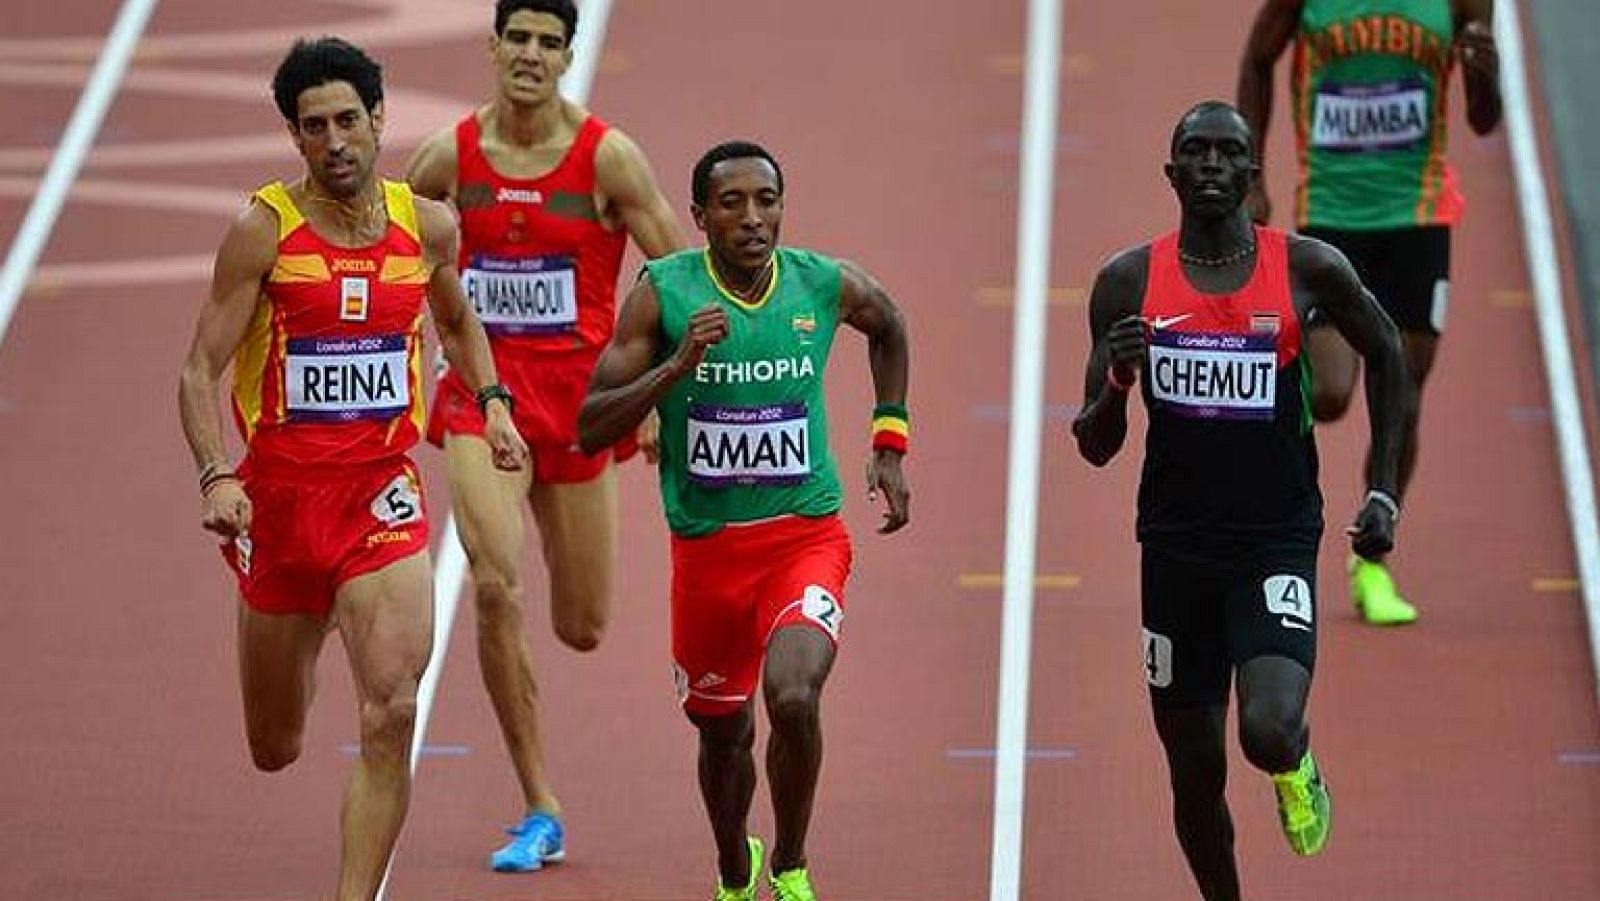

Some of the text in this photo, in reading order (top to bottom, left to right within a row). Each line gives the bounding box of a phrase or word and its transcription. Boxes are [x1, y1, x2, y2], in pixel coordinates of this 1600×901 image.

[1320, 101, 1423, 136] MUMBA
[467, 277, 566, 316] EL MANAOUI
[315, 338, 383, 353] London 2012
[1177, 334, 1247, 348] London 2012
[302, 362, 397, 403] REINA
[695, 356, 815, 383] ETHIOPIA
[1155, 356, 1273, 400] CHEMUT
[716, 407, 783, 420] London 2012
[691, 428, 805, 468] AMAN
[385, 487, 415, 520] 5
[817, 594, 836, 629] 2
[1280, 579, 1302, 612] 4
